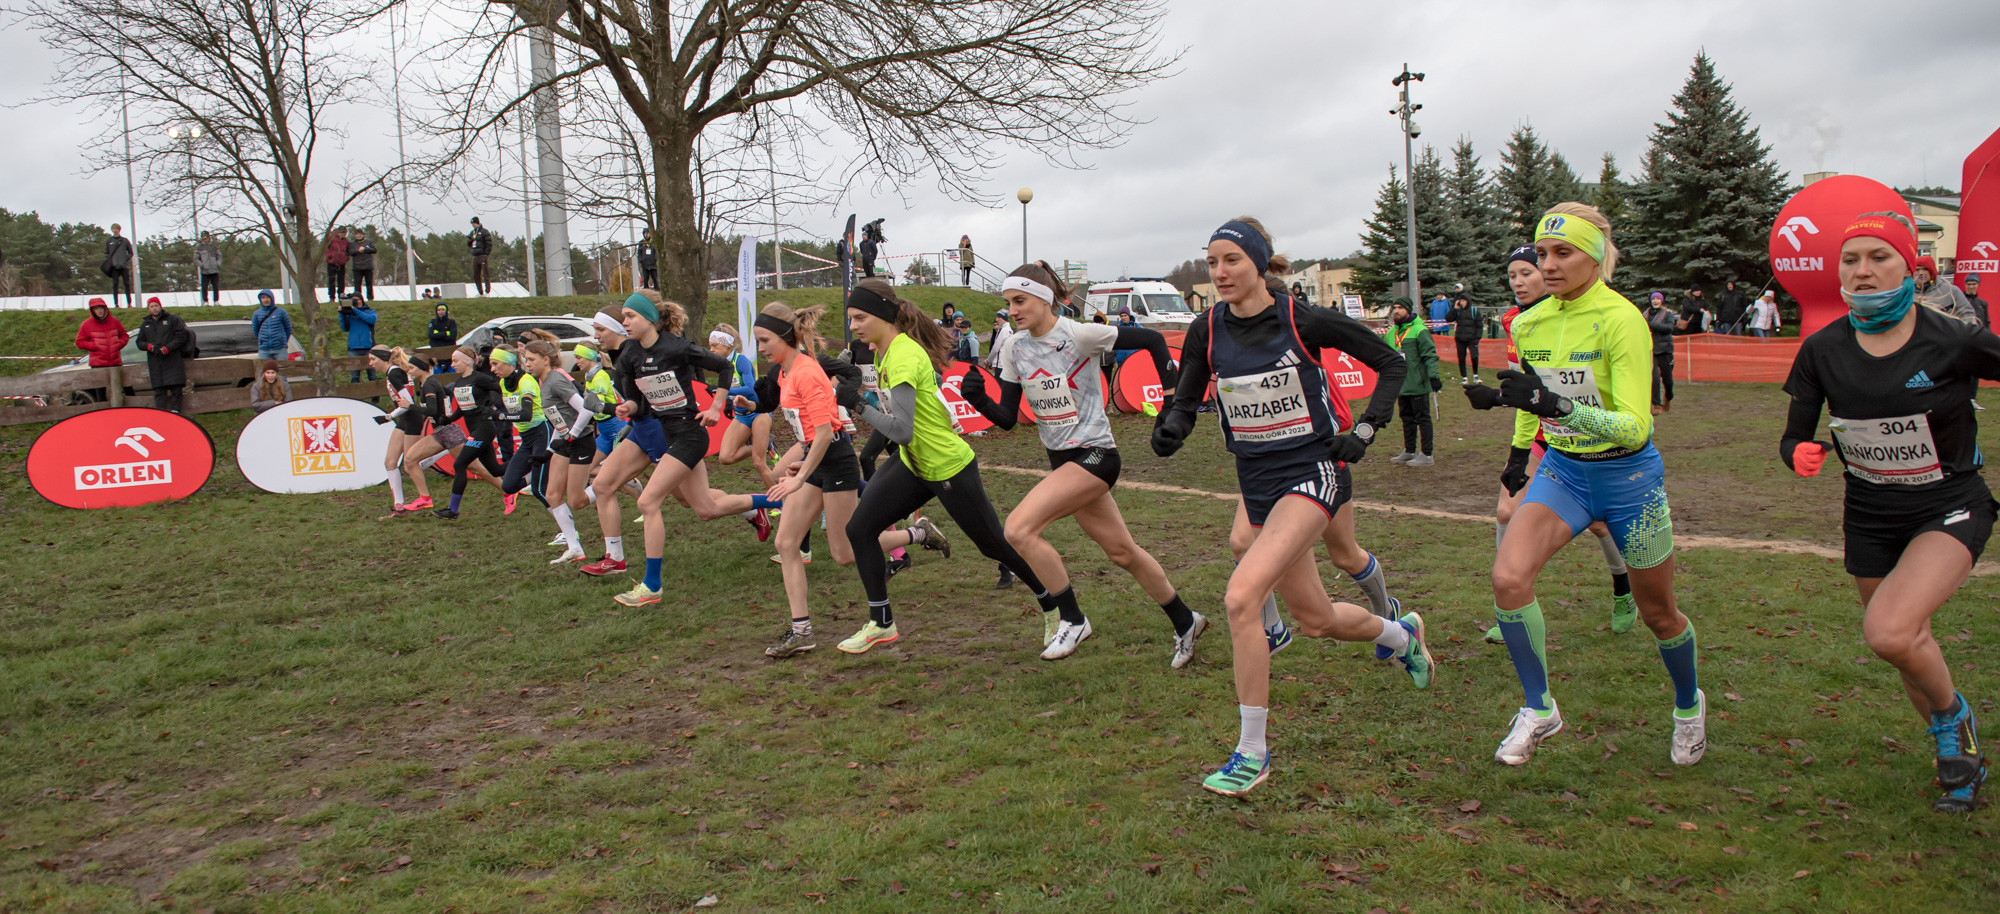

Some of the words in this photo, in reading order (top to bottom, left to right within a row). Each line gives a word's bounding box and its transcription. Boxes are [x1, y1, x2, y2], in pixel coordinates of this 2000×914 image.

[1775, 257, 1823, 272] ORLEN
[1958, 262, 1995, 271] ORLEN
[656, 374, 672, 383] 333
[1041, 378, 1061, 390] 307
[1260, 373, 1289, 389] 437
[1337, 374, 1361, 385] RLEN
[1559, 371, 1585, 384] 317
[1228, 394, 1303, 418] JARZĄBEK
[1266, 429, 1287, 439] GÓRA
[1288, 426, 1306, 434] 2023
[1879, 420, 1918, 435] 304
[465, 440, 483, 448] NIKE
[1840, 443, 1932, 461] BAŃKOWSKA
[294, 454, 352, 472] PZLA
[80, 463, 165, 486] ORLEN
[1853, 468, 1882, 481] ZIELONA
[1911, 474, 1933, 482] 2023
